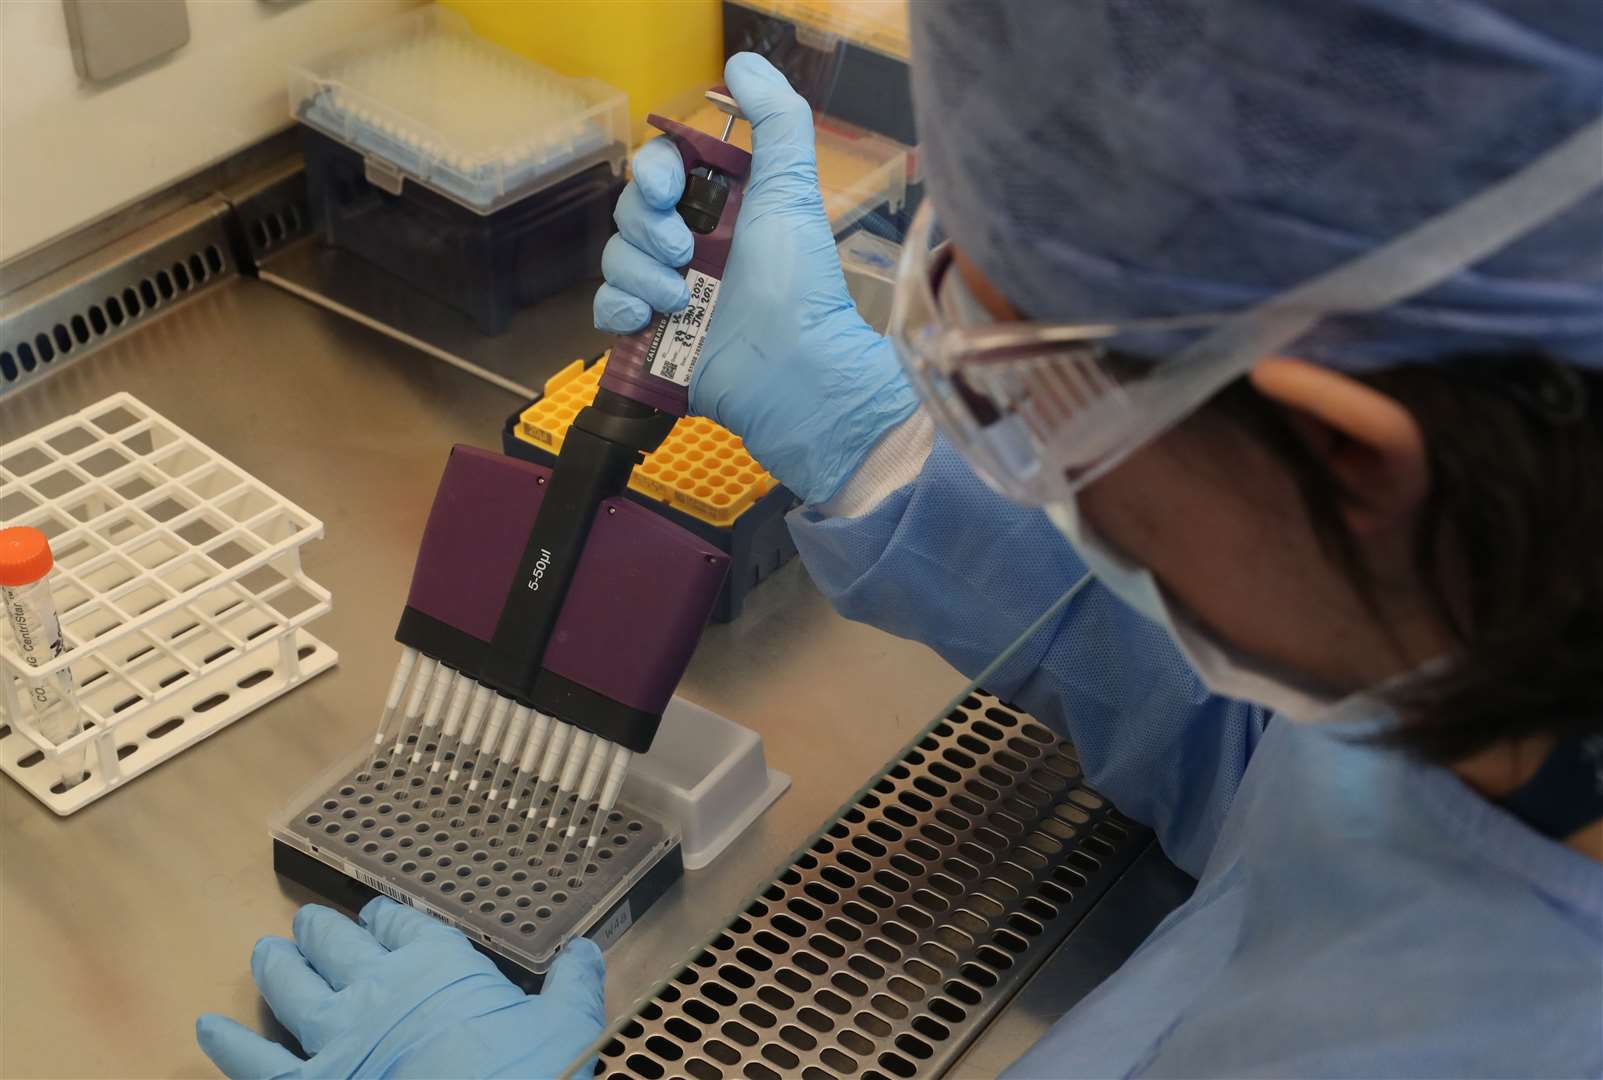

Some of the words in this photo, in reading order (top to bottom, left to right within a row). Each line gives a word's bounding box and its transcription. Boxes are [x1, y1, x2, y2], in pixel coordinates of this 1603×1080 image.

[675, 330, 687, 342] 29
[683, 304, 696, 325] JAN
[691, 277, 705, 299] 2020
[682, 334, 695, 347] 29
[691, 306, 705, 327] JAN
[701, 283, 714, 303] 2021
[647, 318, 667, 362] CALIBRATED
[528, 548, 551, 591] 5-50µl
